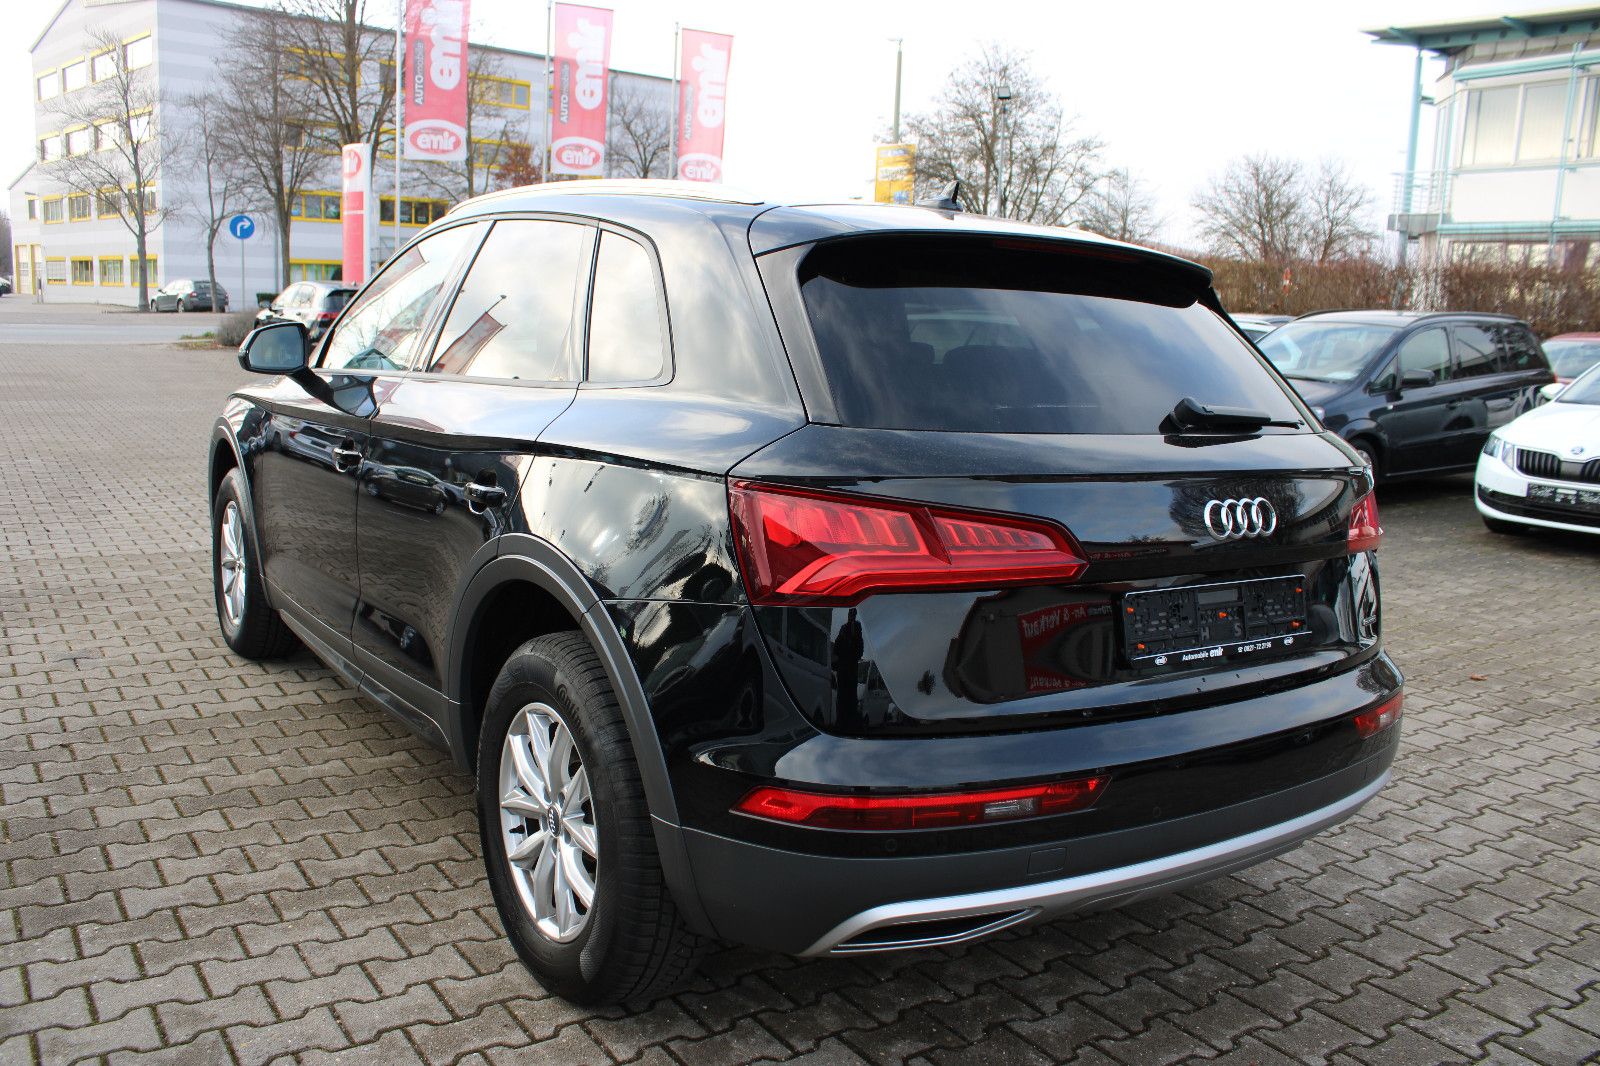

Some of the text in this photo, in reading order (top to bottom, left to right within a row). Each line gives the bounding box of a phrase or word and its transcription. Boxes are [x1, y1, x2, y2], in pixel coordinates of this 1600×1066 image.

[567, 16, 606, 110] emir
[691, 43, 730, 128] emir
[416, 131, 456, 150] emir
[561, 146, 596, 165] emir
